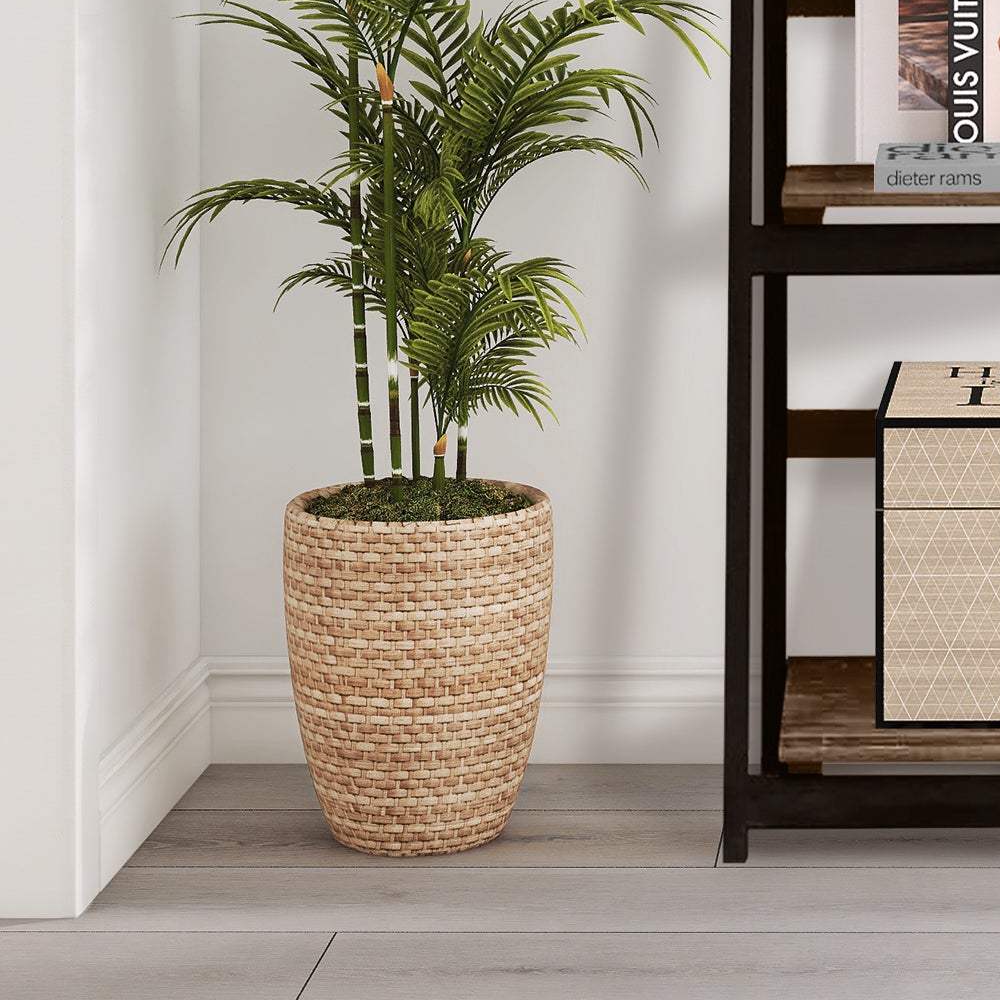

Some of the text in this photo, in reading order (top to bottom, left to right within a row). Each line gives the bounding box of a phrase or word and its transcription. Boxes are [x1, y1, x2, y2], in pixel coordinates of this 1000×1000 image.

[953, 71, 979, 143] OUIS
[886, 170, 982, 186] dieter rams
